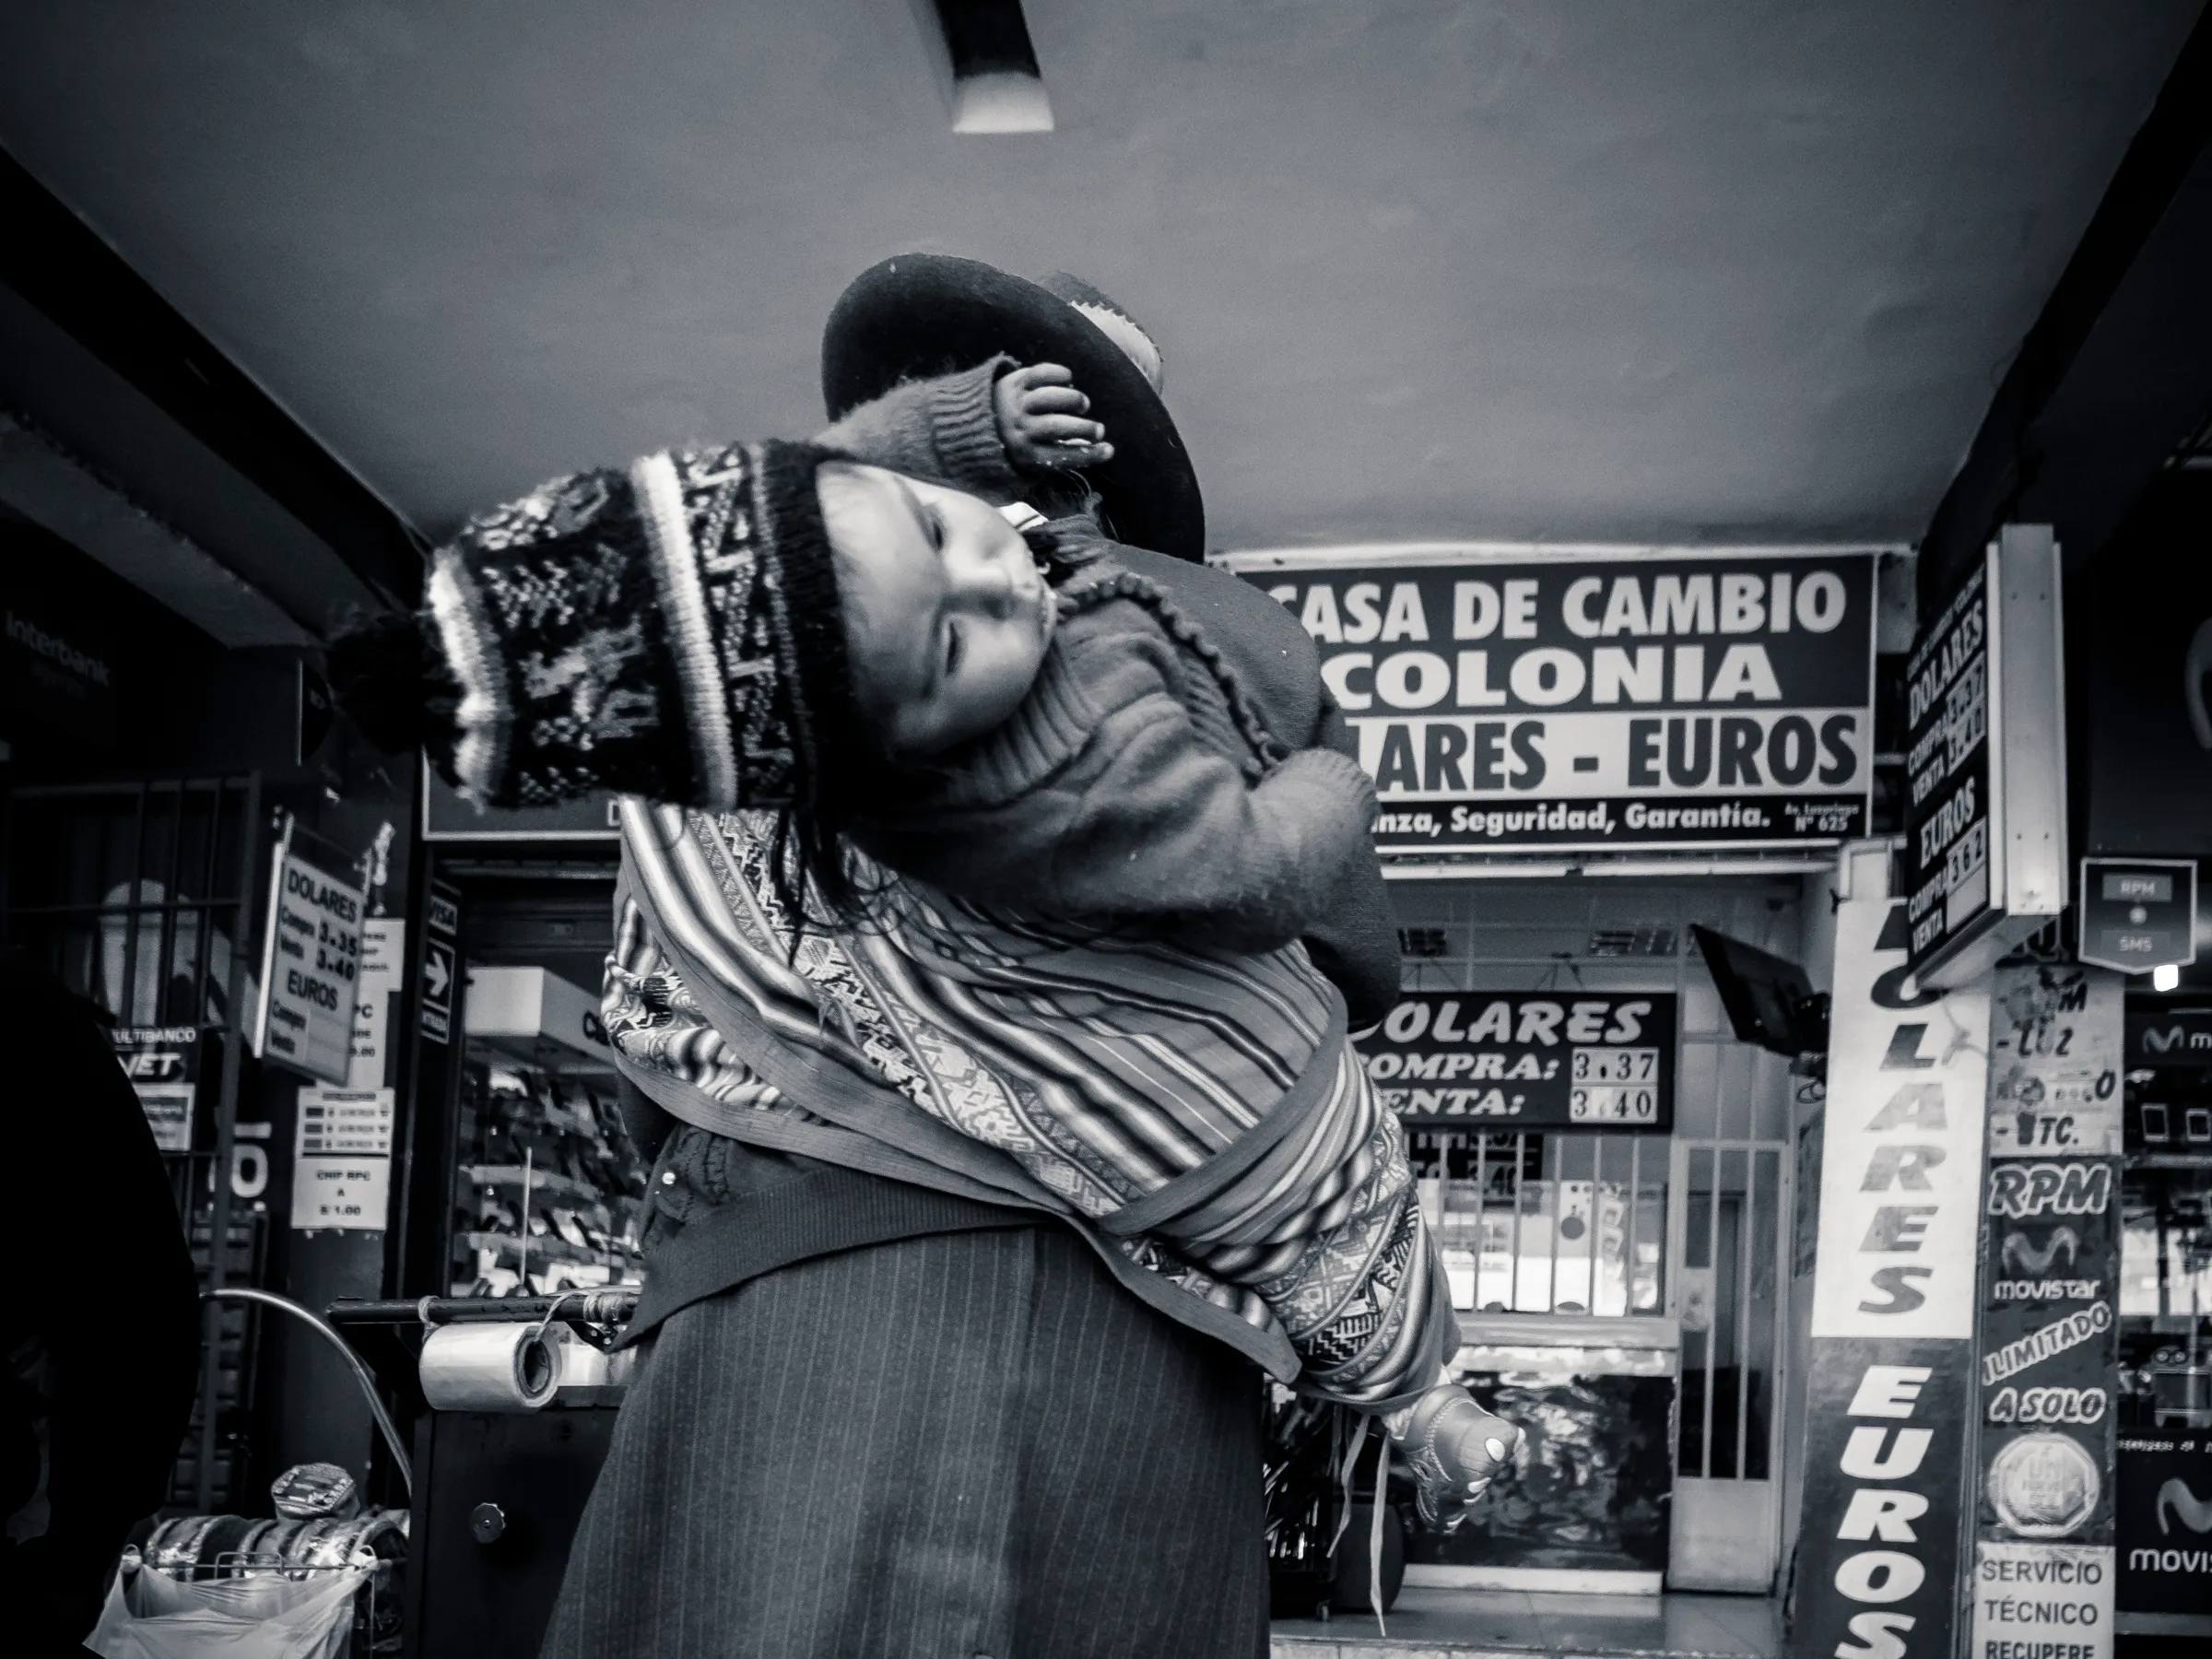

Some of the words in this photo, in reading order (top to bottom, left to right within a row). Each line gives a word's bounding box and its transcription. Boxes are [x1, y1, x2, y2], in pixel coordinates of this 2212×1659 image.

[1453, 579, 1539, 640] DE
[1563, 571, 1846, 639] CAMBIO
[1321, 643, 1783, 711] COLONIA
[1909, 597, 1983, 732] DOLARES
[1347, 718, 1547, 794] ARES
[1628, 714, 1857, 789] EUROS
[1451, 802, 1618, 838] Seguridad,
[1625, 799, 1771, 829] Garantía.
[1920, 774, 1976, 870] EUROS
[288, 870, 358, 923] DOLARES
[288, 970, 338, 1013] EUROS
[1348, 1000, 1653, 1047] OLARES
[1382, 1087, 1526, 1115] ENTA:
[1987, 1162, 2112, 1219] RPM
[1994, 1278, 2102, 1300] movistar
[1983, 1300, 2113, 1386] ILIMITADO
[1988, 1386, 2018, 1423] A
[2018, 1386, 2108, 1425] SOLO
[1834, 1364, 1935, 1659] EUROS
[1982, 1559, 2103, 1586] SERVICIO
[2128, 1547, 2212, 1573] movi
[1984, 1594, 2099, 1627] TÉCNICO
[1985, 1640, 2097, 1659] RECUPERE
